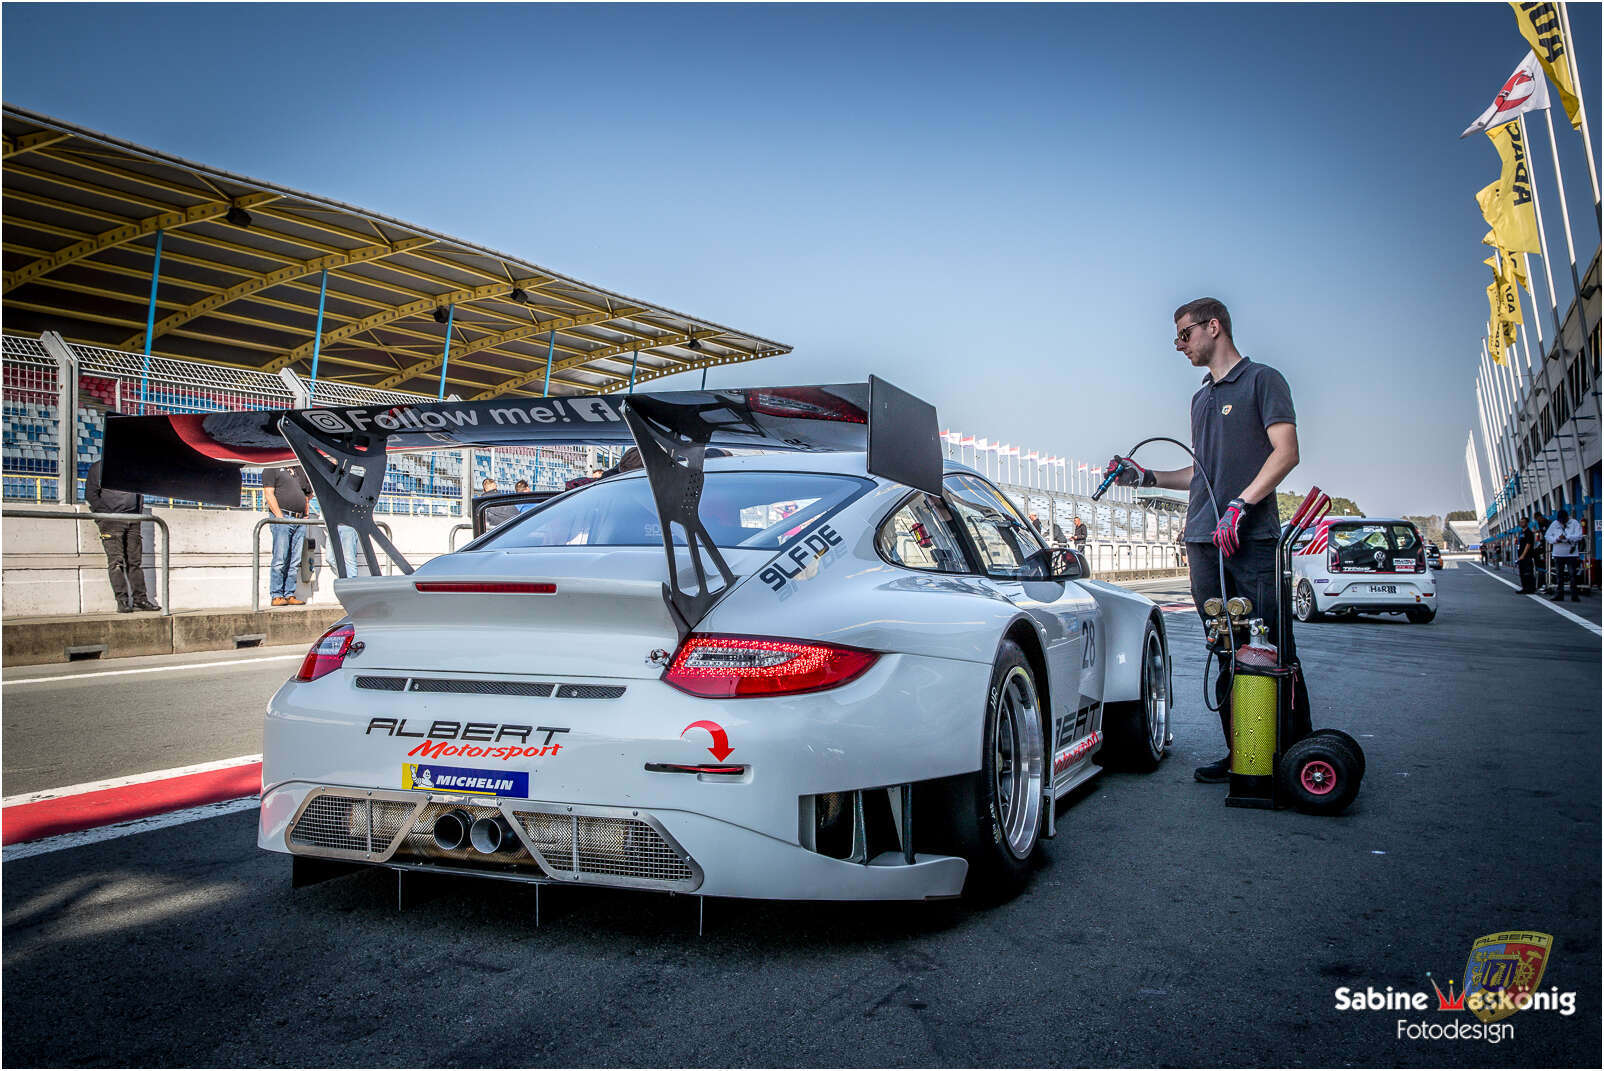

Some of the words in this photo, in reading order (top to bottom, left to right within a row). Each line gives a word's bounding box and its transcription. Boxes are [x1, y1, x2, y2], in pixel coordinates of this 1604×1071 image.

[1505, 122, 1532, 206] ADAC
[346, 407, 479, 431] Follow
[489, 400, 570, 424] me!
[760, 525, 843, 592] 9LF.DE
[1082, 620, 1096, 669] 28
[366, 718, 570, 745] ALBERT
[408, 740, 563, 760] Motorsport
[436, 775, 514, 791] MICHELIN
